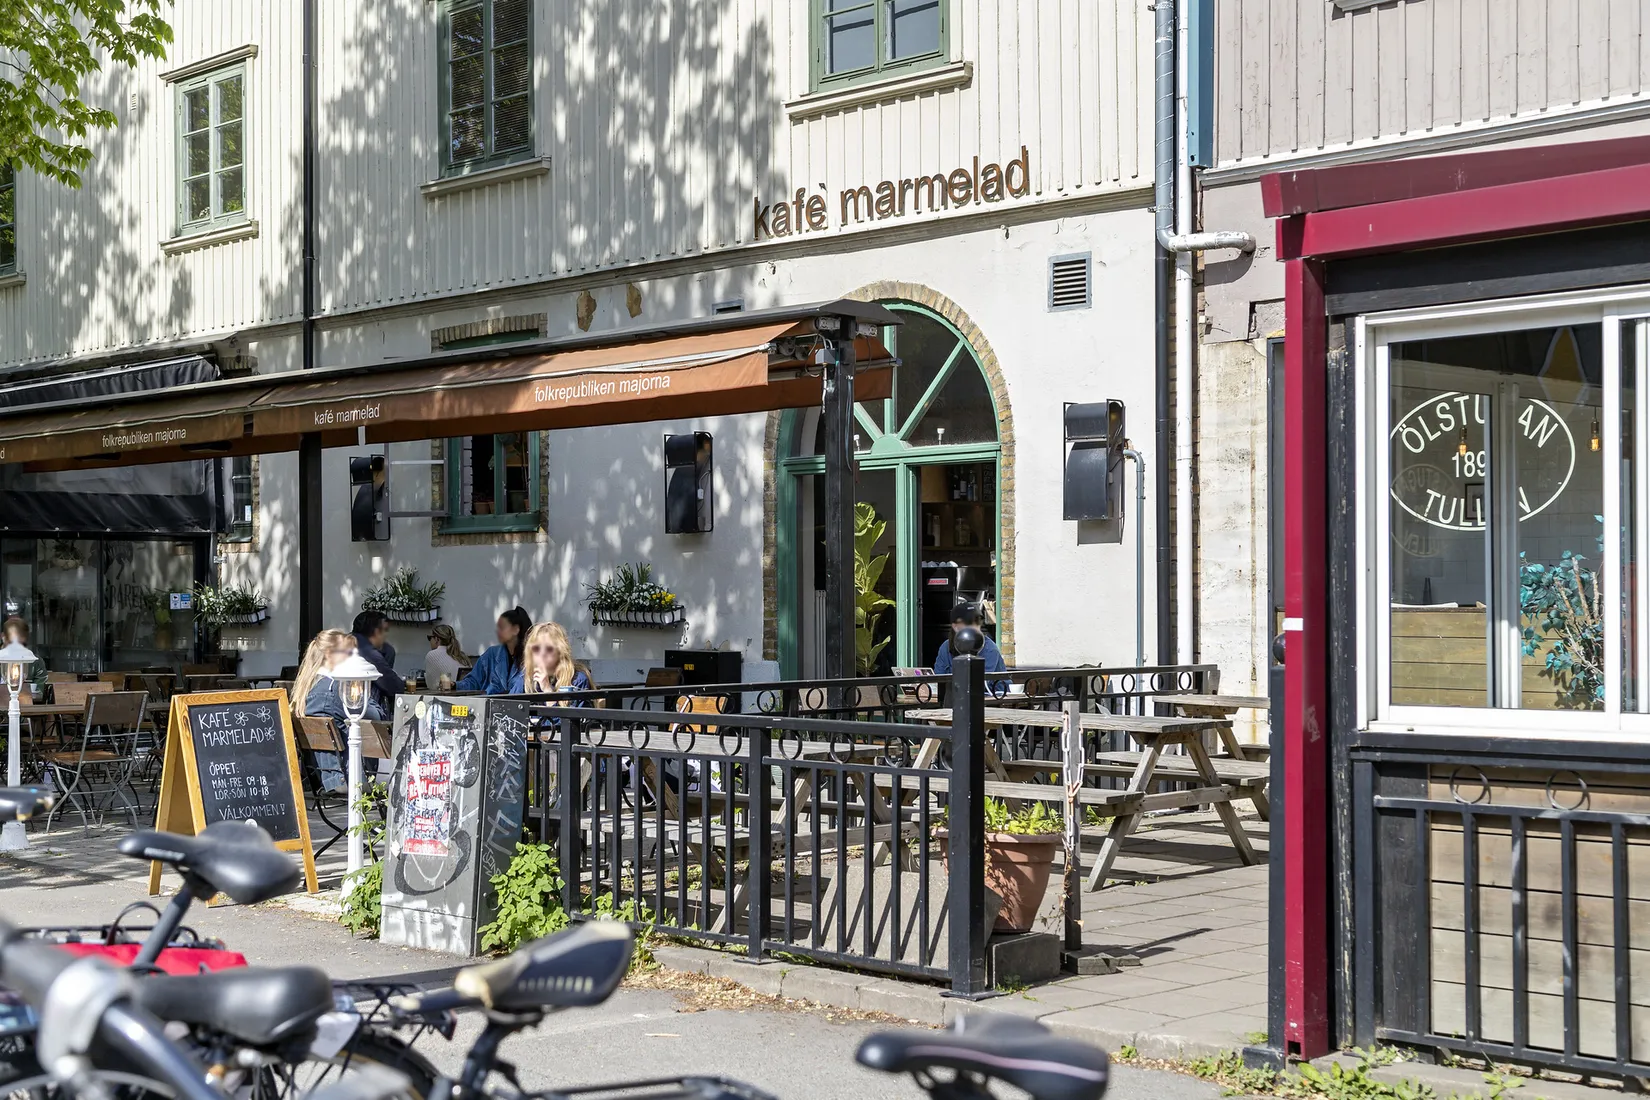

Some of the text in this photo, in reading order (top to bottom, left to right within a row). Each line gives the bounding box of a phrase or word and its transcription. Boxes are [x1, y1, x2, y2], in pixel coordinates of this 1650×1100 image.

[840, 145, 1029, 226] marmelad
[535, 375, 671, 402] folkrepubliken majorna
[314, 403, 380, 425] kafé marmelad
[102, 428, 187, 448] folkrepubliken majorna
[1451, 450, 1486, 478] 189
[198, 708, 232, 730] KAFÉ
[202, 728, 265, 747] MARMELAD
[209, 762, 240, 776] ÖPPET:
[249, 786, 270, 798] 10-18
